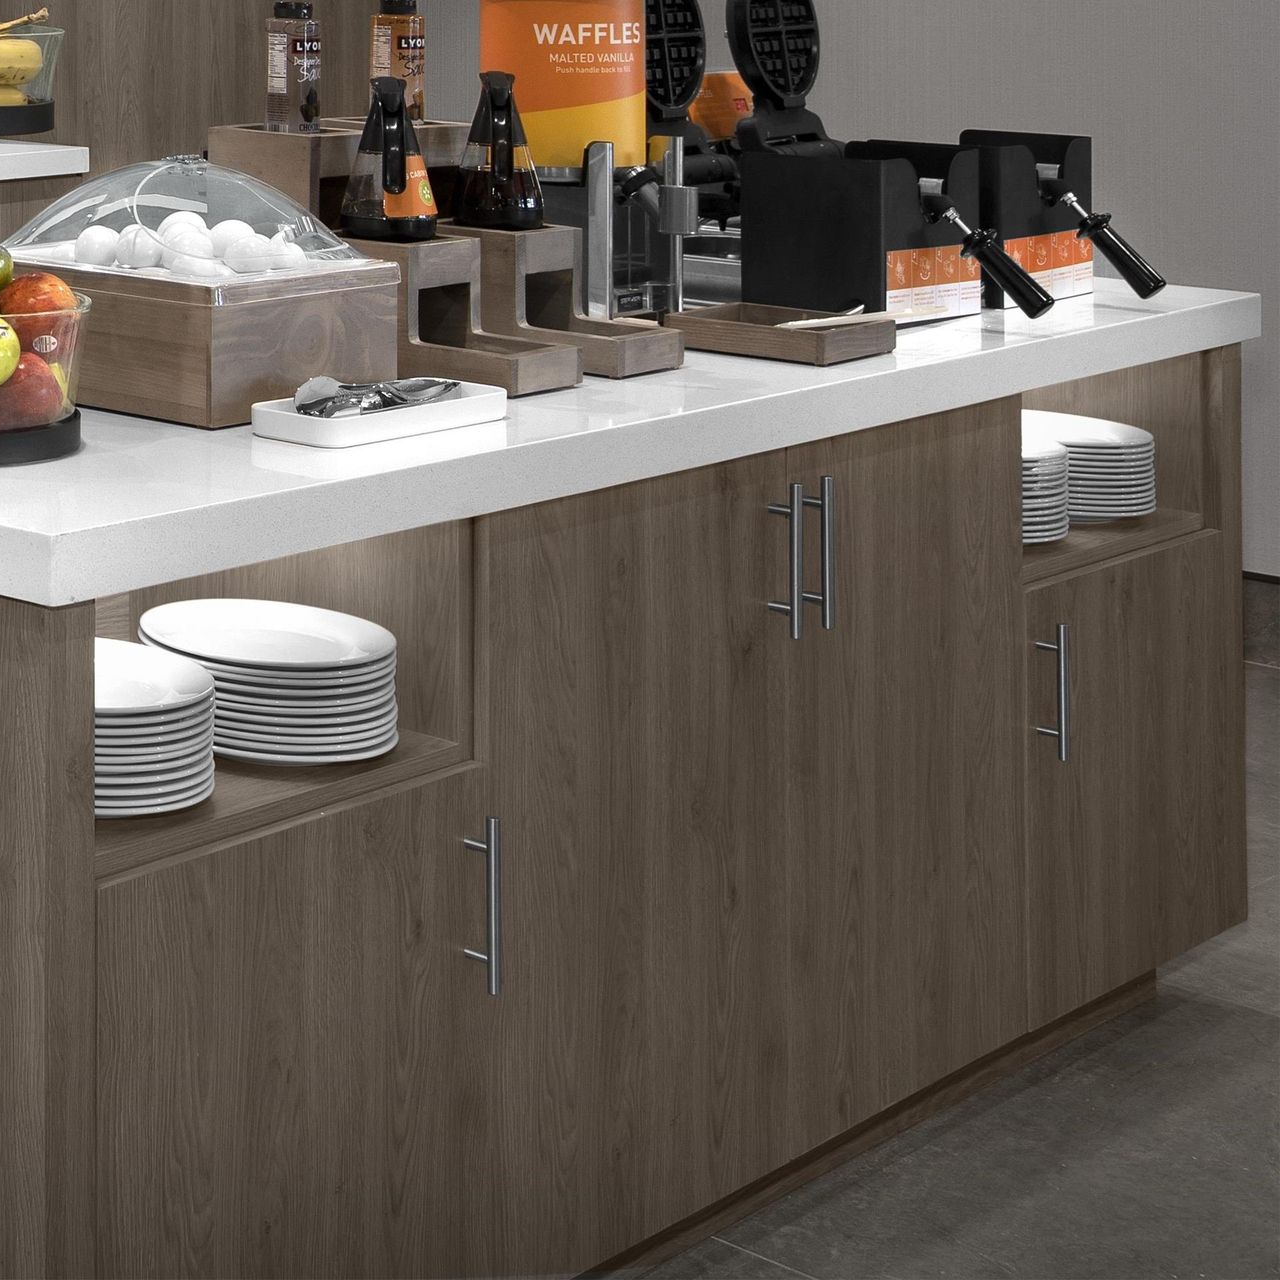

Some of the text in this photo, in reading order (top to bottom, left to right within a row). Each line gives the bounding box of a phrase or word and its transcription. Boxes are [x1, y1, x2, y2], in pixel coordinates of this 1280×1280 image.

[533, 22, 641, 45] WAFFLES
[549, 52, 635, 63] MALTED VANILLA
